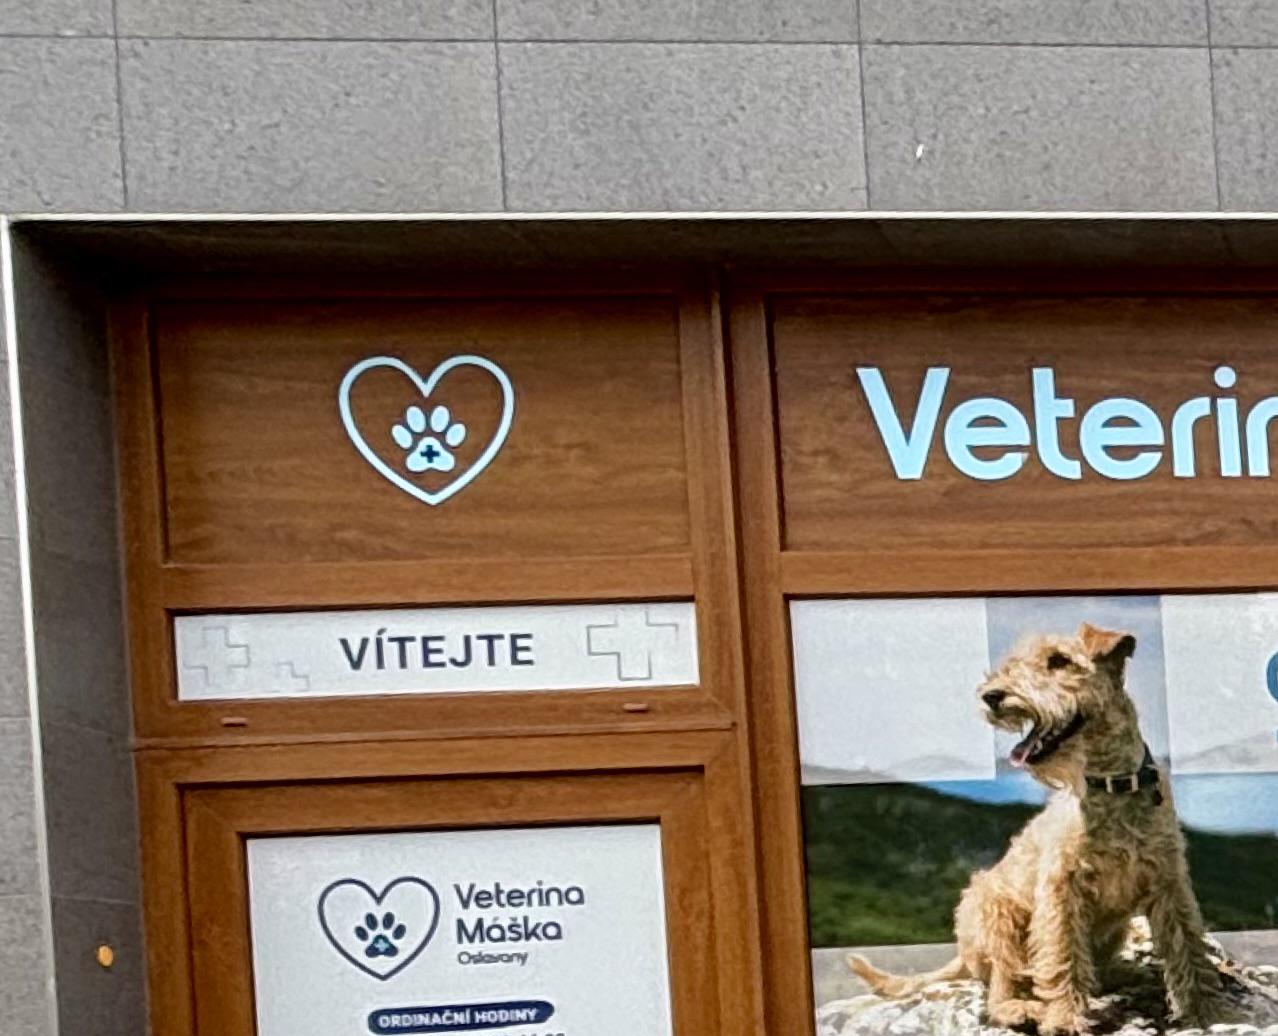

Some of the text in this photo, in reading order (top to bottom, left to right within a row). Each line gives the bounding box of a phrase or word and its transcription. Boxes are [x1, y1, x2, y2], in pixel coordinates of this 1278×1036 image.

[339, 628, 534, 671] VÍTEJTE
[453, 880, 585, 910] Veterina
[456, 915, 563, 944] Máška
[457, 951, 528, 966] Oslavany
[378, 1007, 538, 1028] ORDINAČNÍ HODINY
